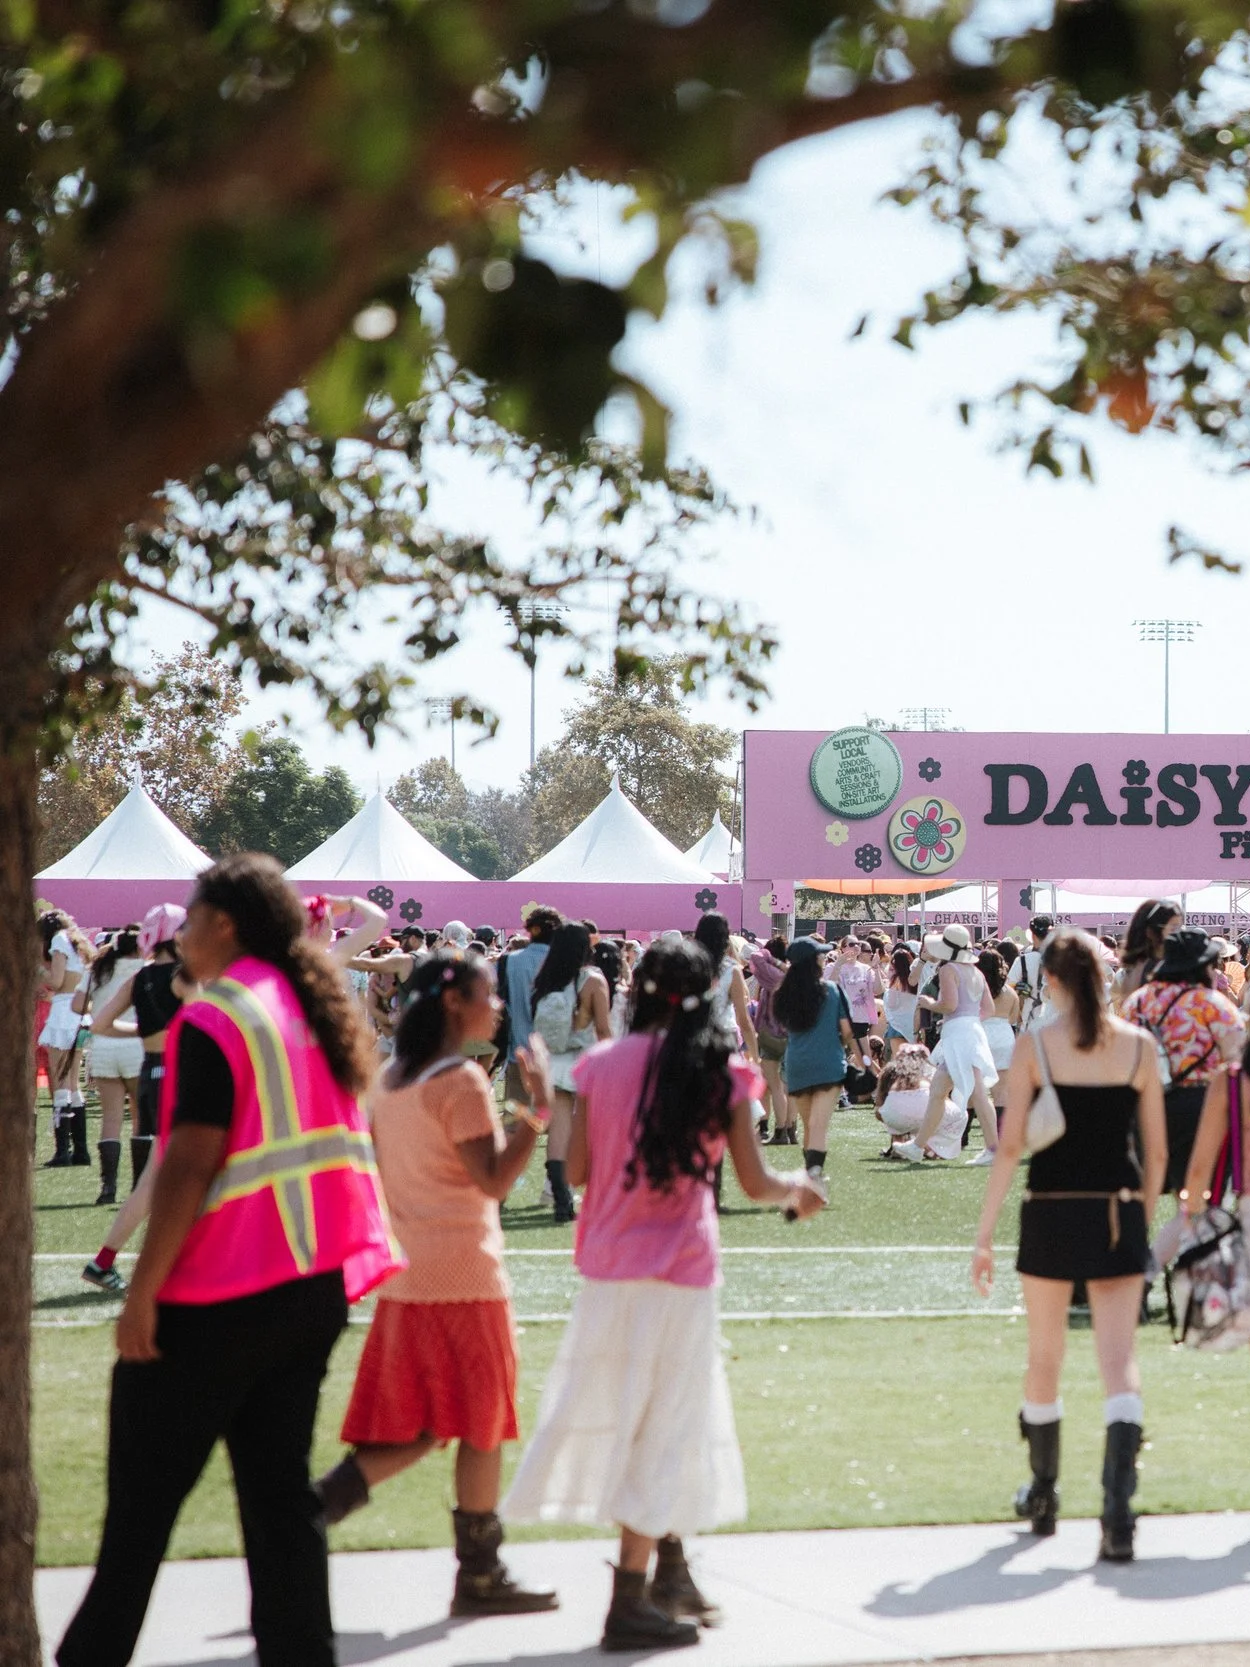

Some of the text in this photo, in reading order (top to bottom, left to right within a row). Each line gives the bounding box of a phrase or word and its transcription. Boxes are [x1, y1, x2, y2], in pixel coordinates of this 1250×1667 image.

[833, 735, 870, 750] SUPPORT
[841, 747, 866, 759] LOCAL
[838, 764, 875, 776] COMMUNITY
[835, 775, 853, 786] ARTS
[860, 770, 881, 781] CRAFT
[840, 778, 879, 793] SESSIONS &
[839, 793, 886, 807] INSTALLATIONS
[841, 786, 880, 800] ON-SITE ART
